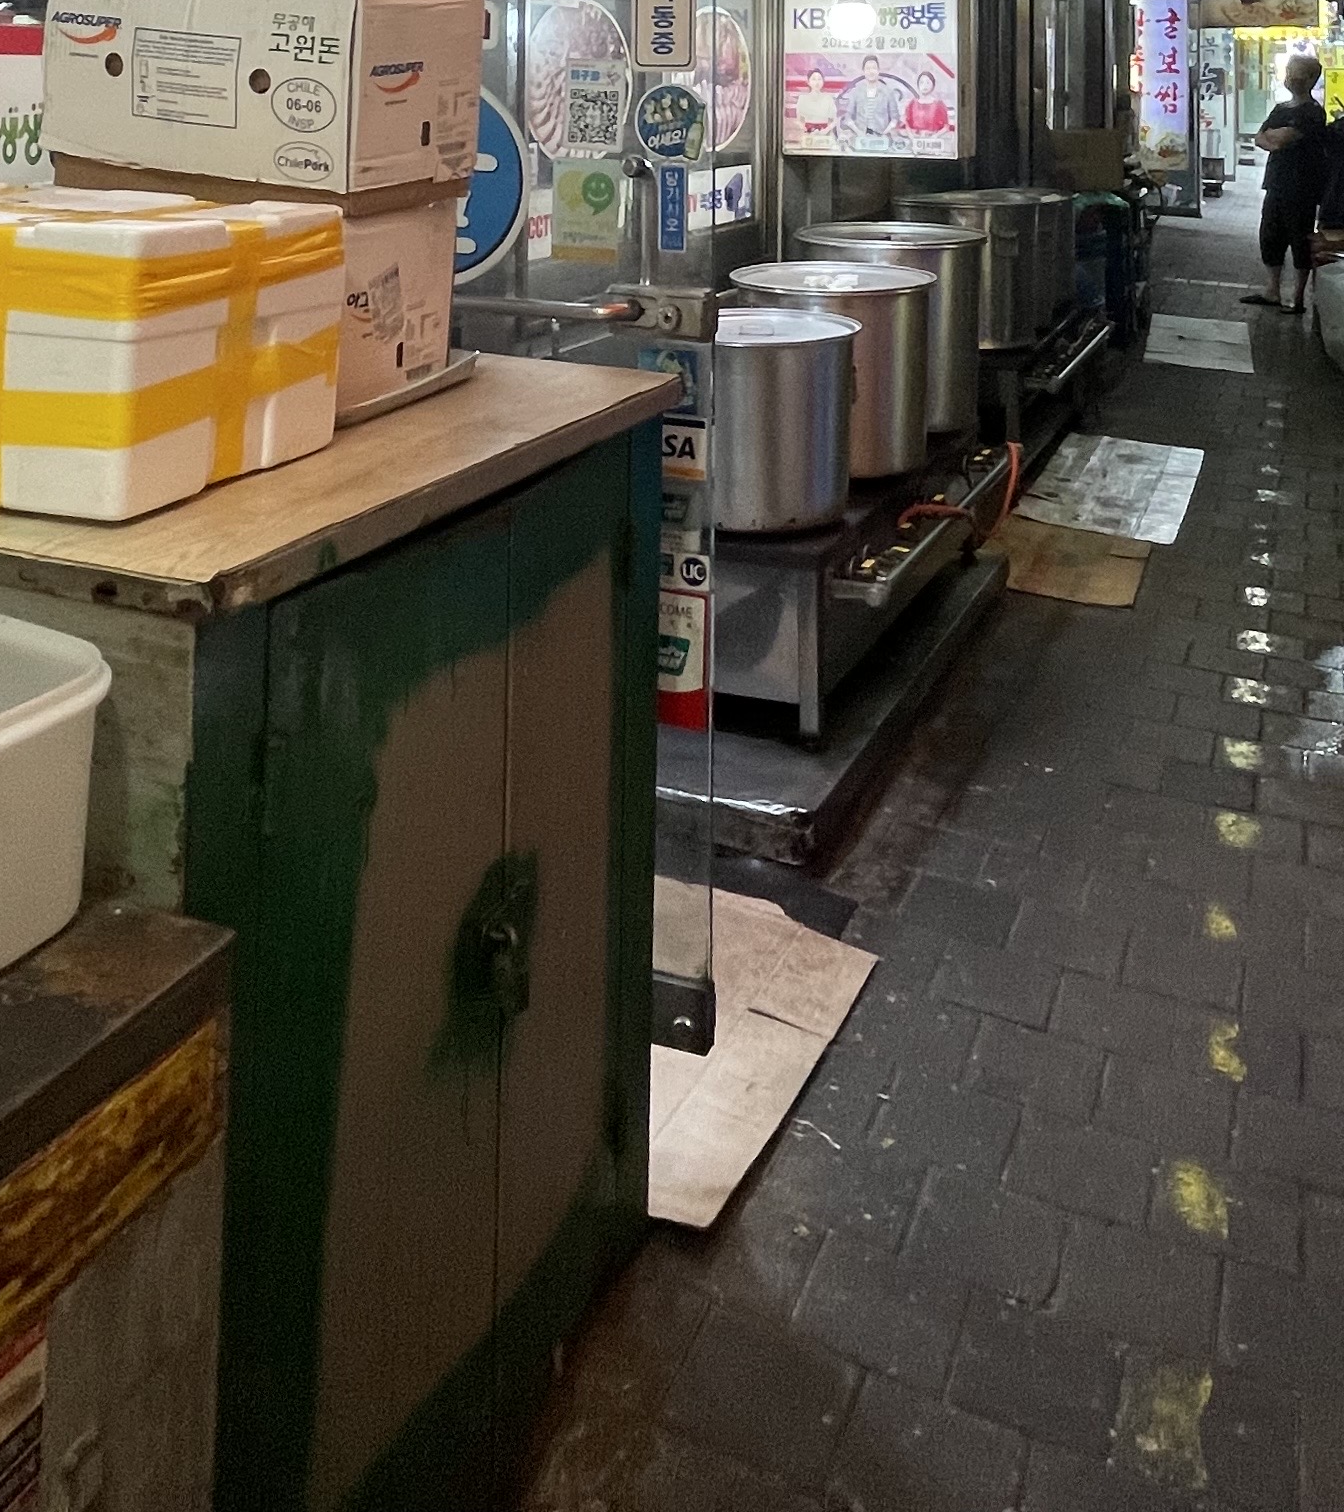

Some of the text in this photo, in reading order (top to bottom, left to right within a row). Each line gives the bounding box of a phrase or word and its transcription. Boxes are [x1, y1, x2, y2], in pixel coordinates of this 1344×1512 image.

[51, 10, 122, 30] AGROSUPER
[268, 32, 341, 65] 고원돈
[286, 81, 321, 97] CHILE
[286, 98, 323, 114] 06-06
